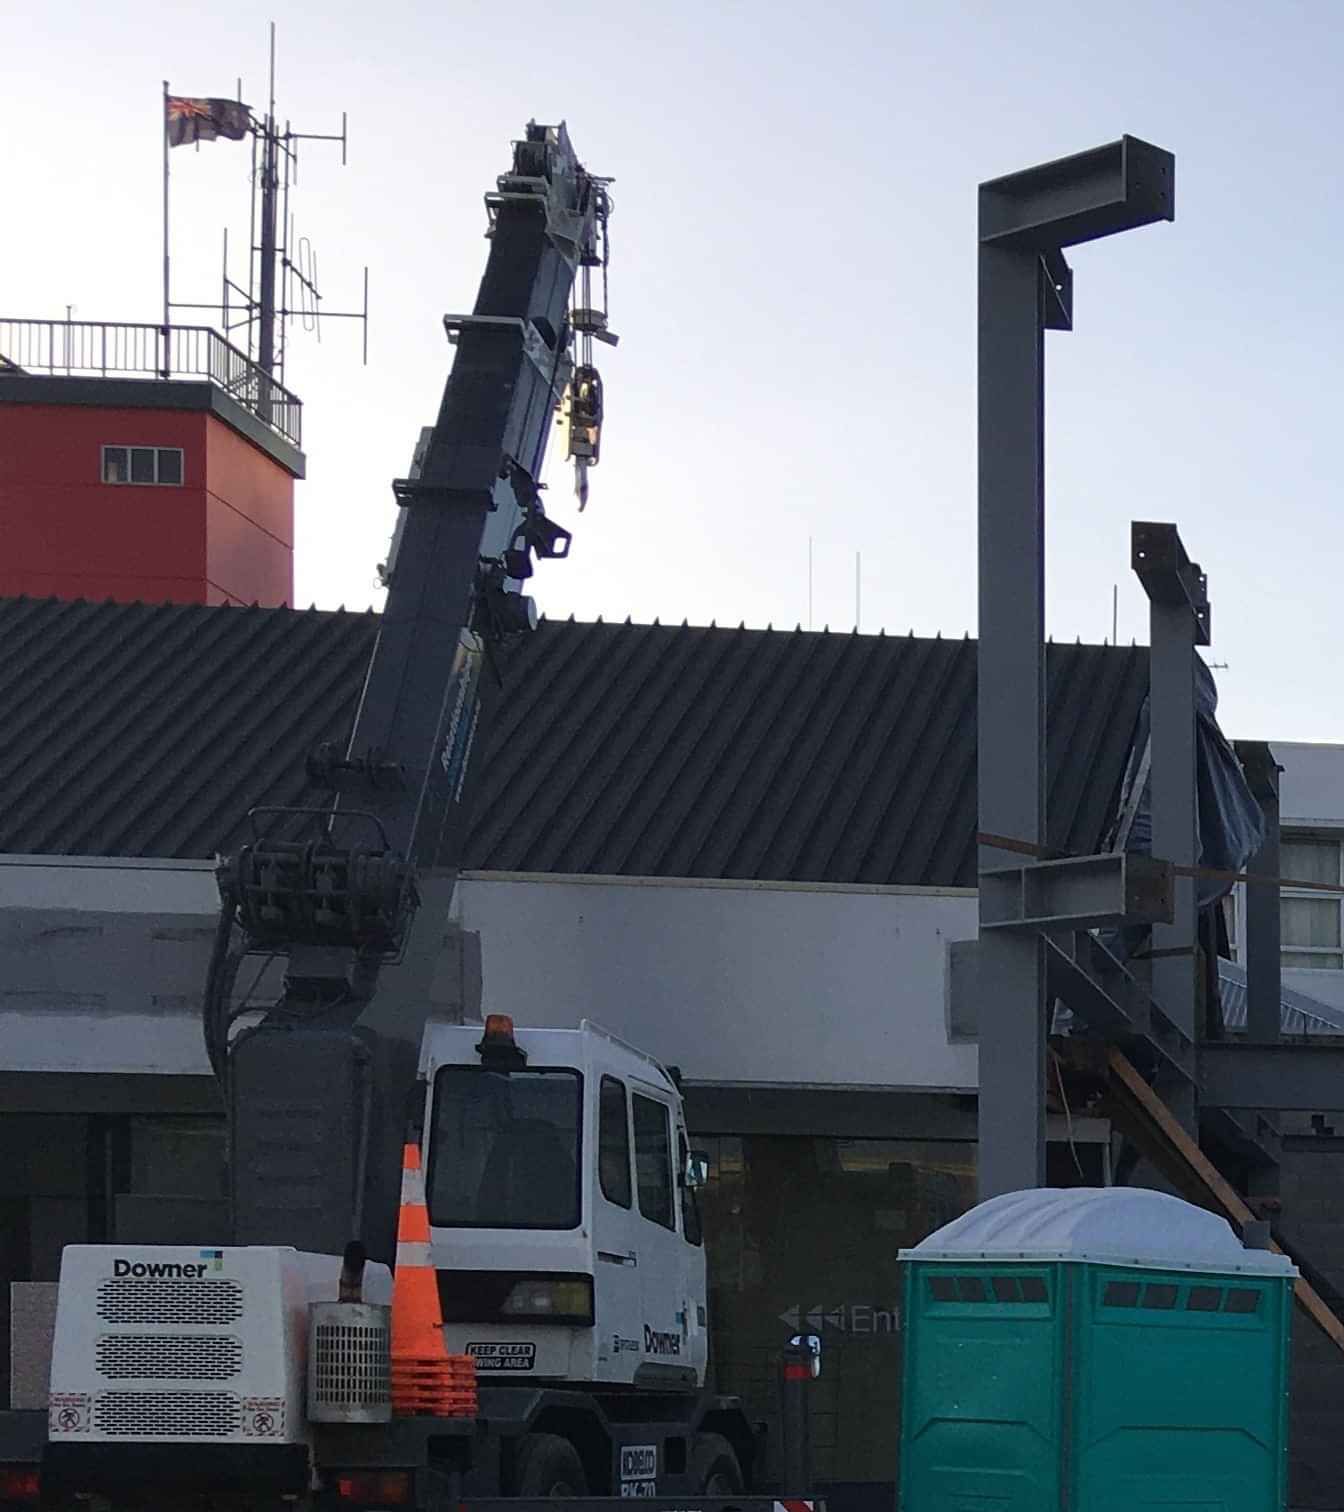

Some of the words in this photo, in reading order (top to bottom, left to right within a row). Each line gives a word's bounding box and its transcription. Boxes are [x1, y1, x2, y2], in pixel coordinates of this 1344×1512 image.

[114, 1259, 208, 1278] Downer
[644, 1324, 681, 1355] Downer
[470, 1345, 497, 1355] KEEP
[499, 1345, 531, 1355] CLEAR
[475, 1358, 501, 1368] WING
[503, 1358, 530, 1368] AREA
